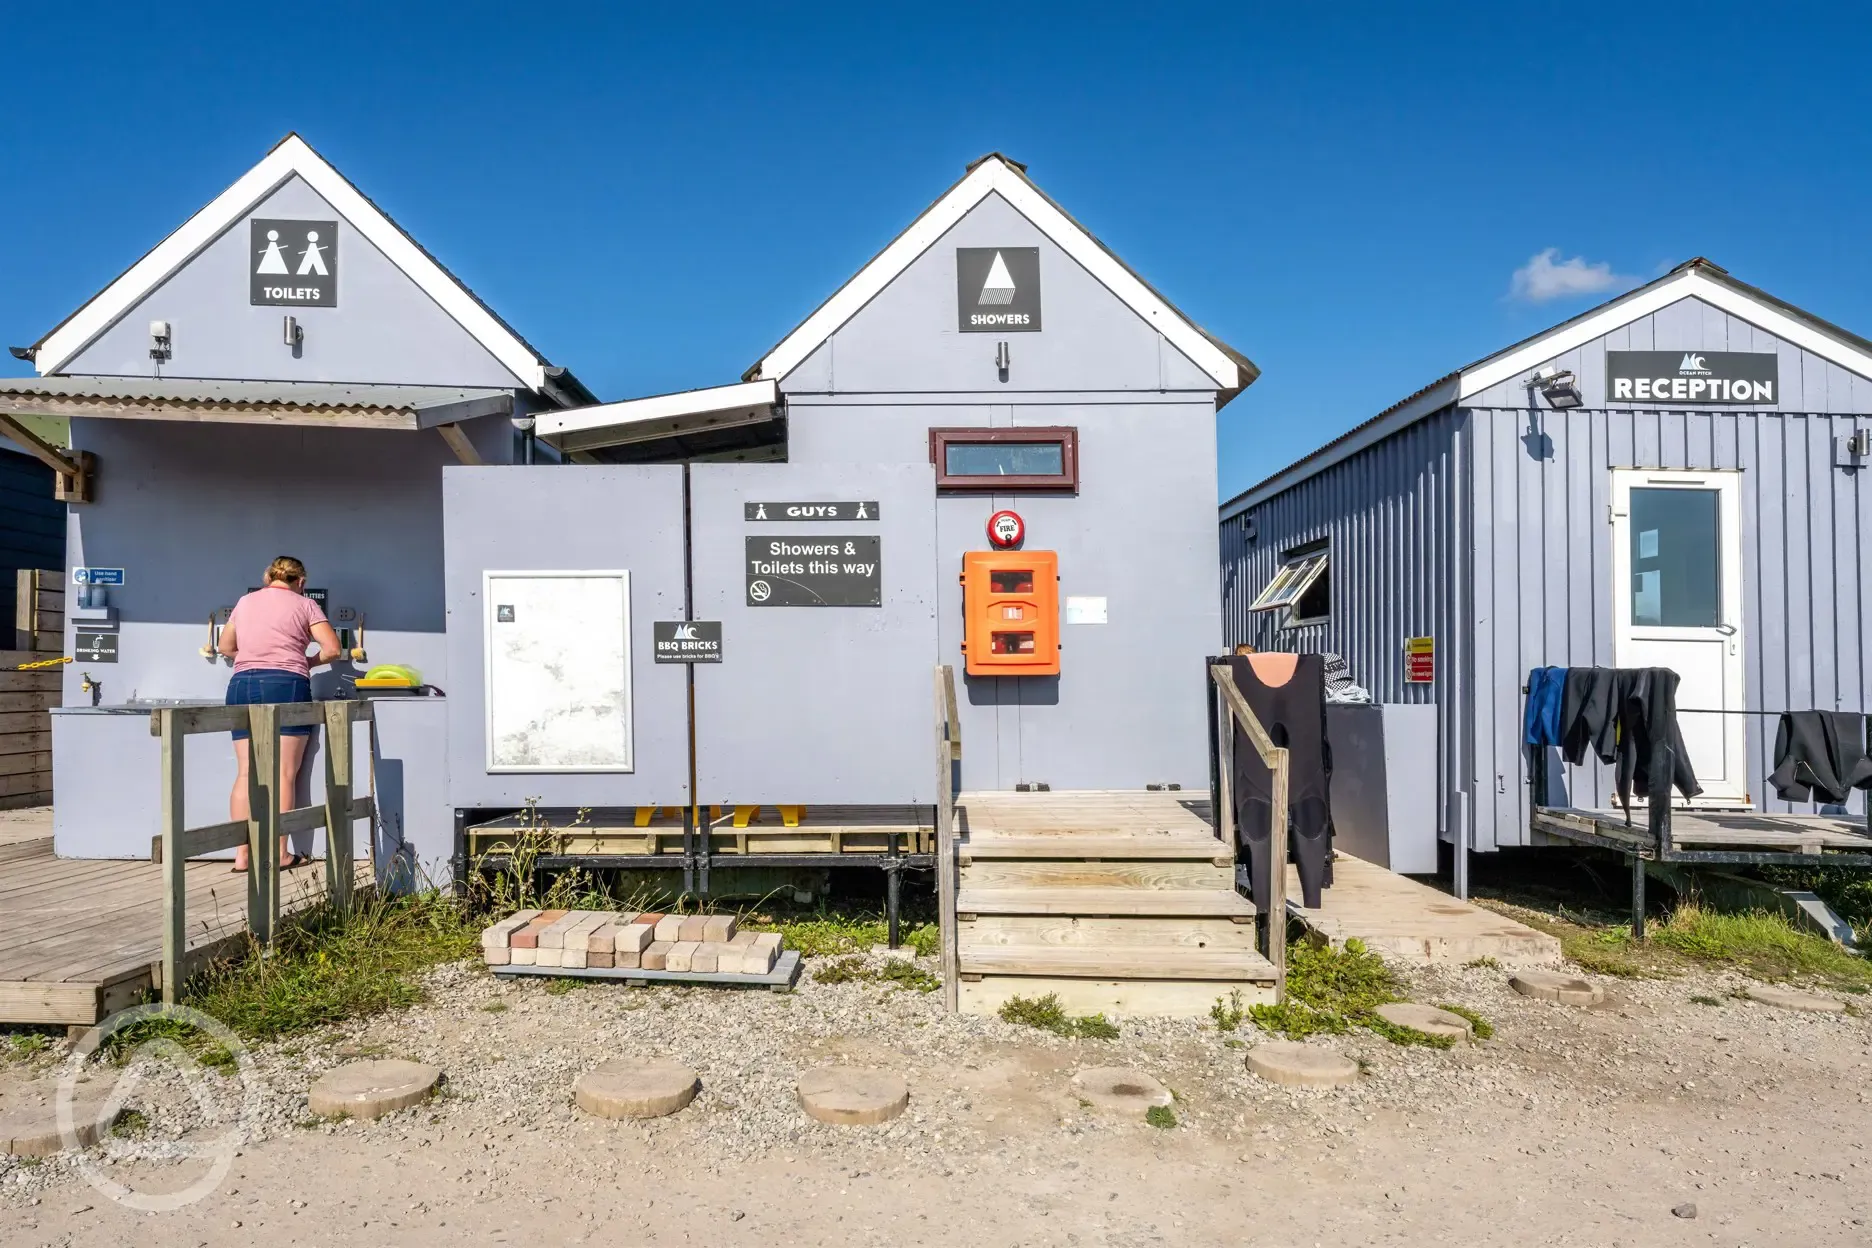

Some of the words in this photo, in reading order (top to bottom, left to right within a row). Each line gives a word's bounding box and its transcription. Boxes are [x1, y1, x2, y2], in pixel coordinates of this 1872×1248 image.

[263, 287, 320, 300] TOILETS
[970, 313, 1030, 325] SHOWERS
[1614, 378, 1772, 401] RECEPTION
[786, 506, 838, 517] GUYS
[770, 541, 839, 556] Showers
[843, 541, 857, 556] &
[751, 560, 804, 574] Toilets
[808, 560, 839, 575] this
[842, 563, 875, 577] way
[658, 641, 678, 651] BBQ
[681, 641, 718, 650] BRICKS
